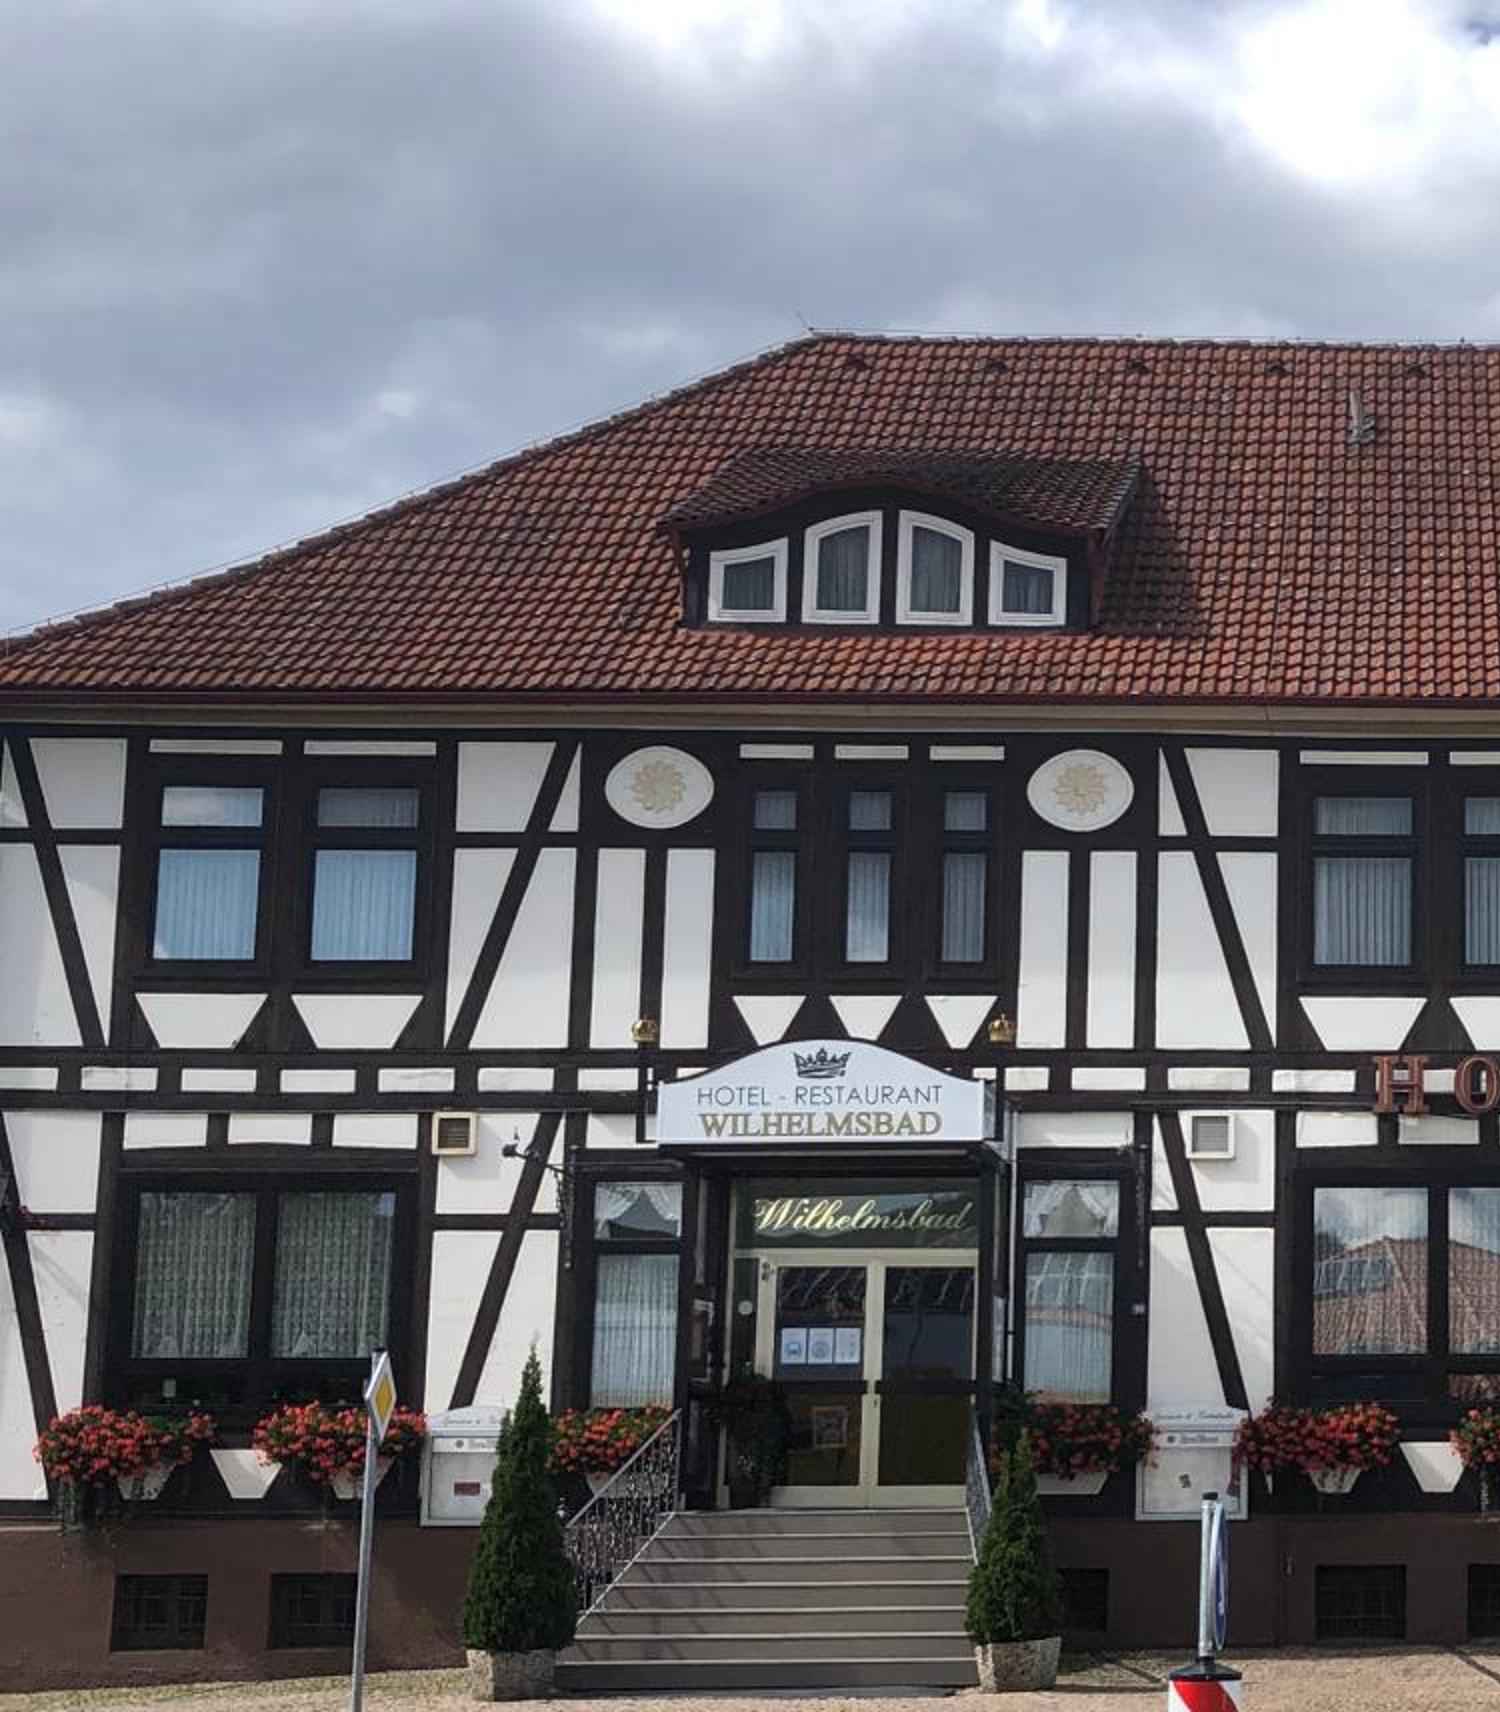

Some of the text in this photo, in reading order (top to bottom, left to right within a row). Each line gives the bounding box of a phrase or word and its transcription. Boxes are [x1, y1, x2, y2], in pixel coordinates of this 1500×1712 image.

[697, 1085, 770, 1106] HOTEL
[795, 1084, 942, 1105] RESTAURANT
[698, 1110, 942, 1137] WILHELMSBAD
[754, 1198, 974, 1231] Wilhelmsbad
